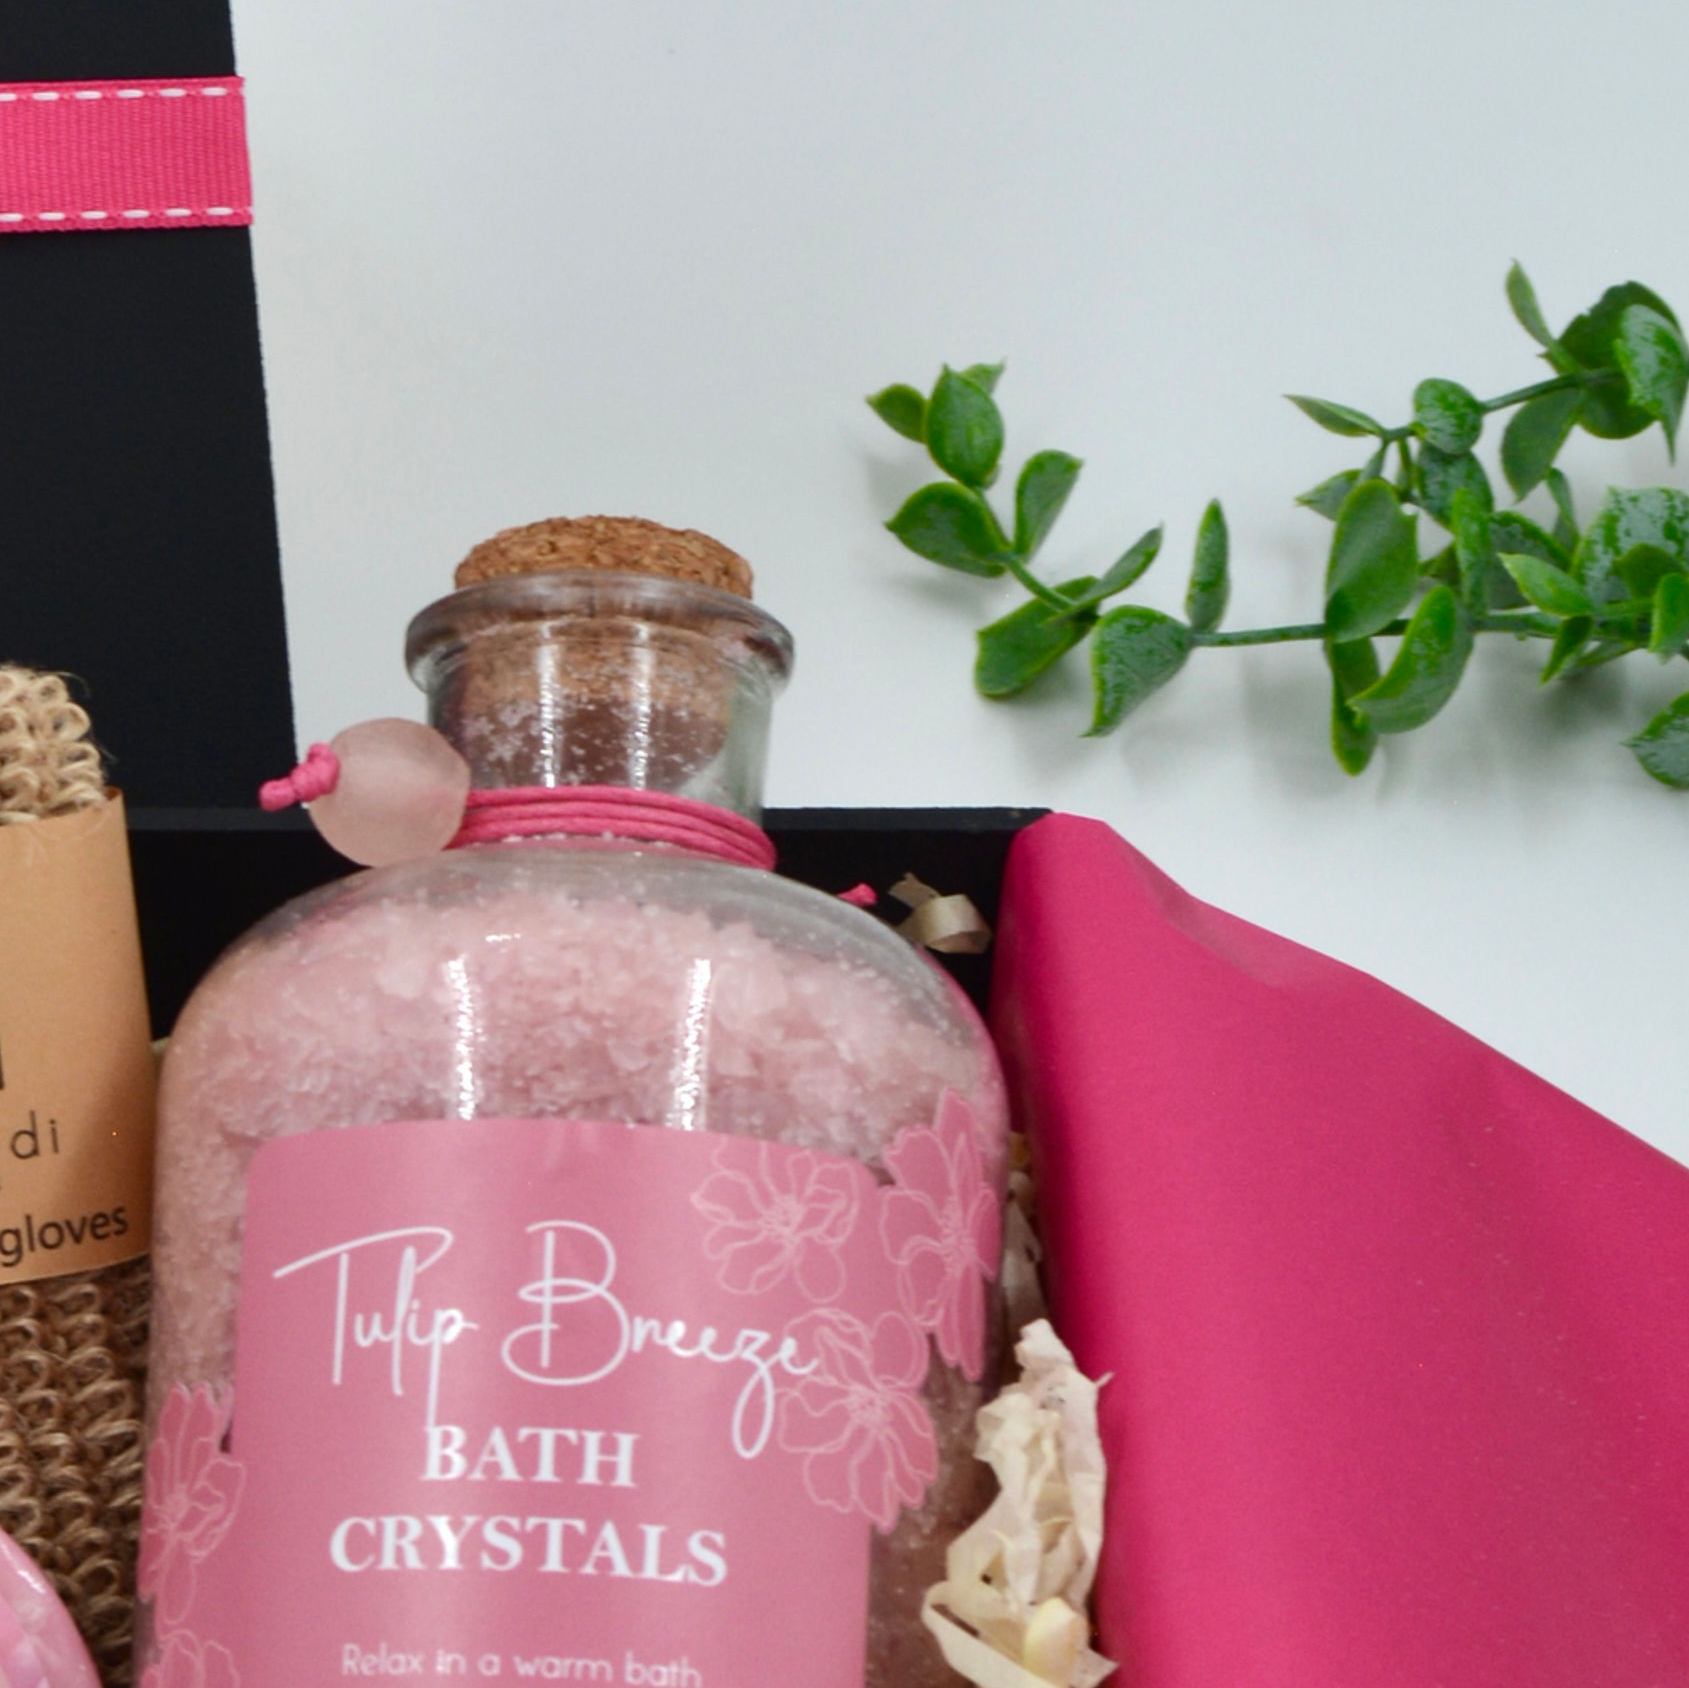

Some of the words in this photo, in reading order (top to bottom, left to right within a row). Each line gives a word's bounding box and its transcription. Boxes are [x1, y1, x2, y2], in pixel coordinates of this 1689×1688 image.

[273, 1226, 480, 1428] Tulip
[502, 1221, 819, 1459] Breeze
[420, 1424, 641, 1488] BATH
[329, 1515, 728, 1588] CRYSTALS
[341, 1642, 423, 1676] Relax
[436, 1648, 466, 1674] in
[477, 1652, 501, 1676] a
[513, 1654, 612, 1682] warm
